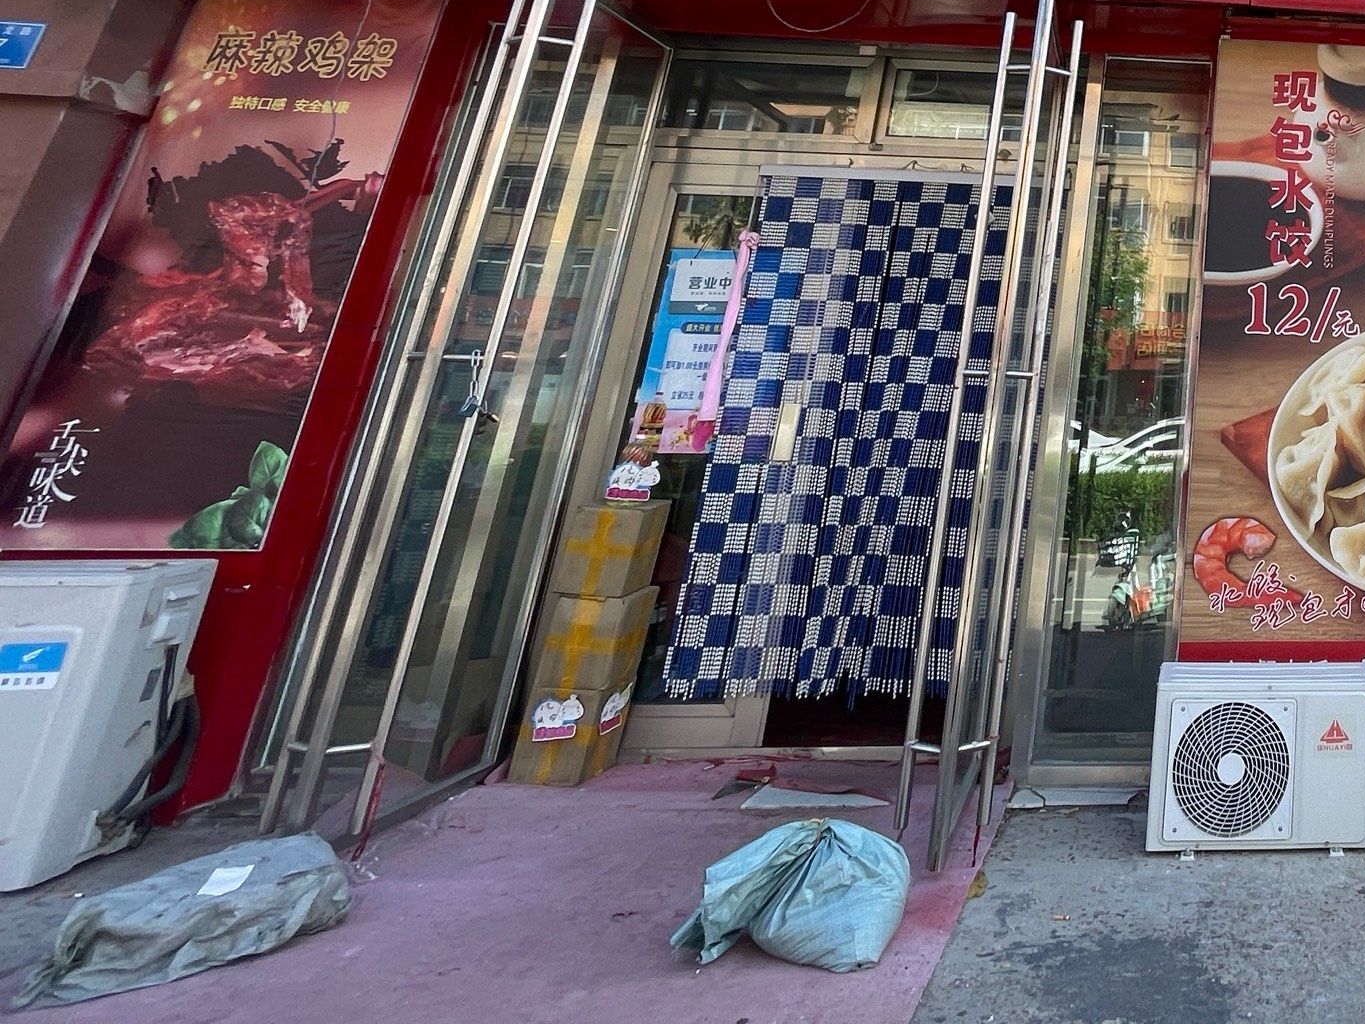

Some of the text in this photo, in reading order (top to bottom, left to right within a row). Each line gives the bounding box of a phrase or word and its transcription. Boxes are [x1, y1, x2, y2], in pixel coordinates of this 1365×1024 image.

[201, 26, 397, 81] 麻辣鸡架
[1265, 71, 1318, 268] 现包水饺
[1325, 174, 1336, 205] MADE
[689, 276, 732, 290] 营业中
[1244, 281, 1361, 344] 12/元
